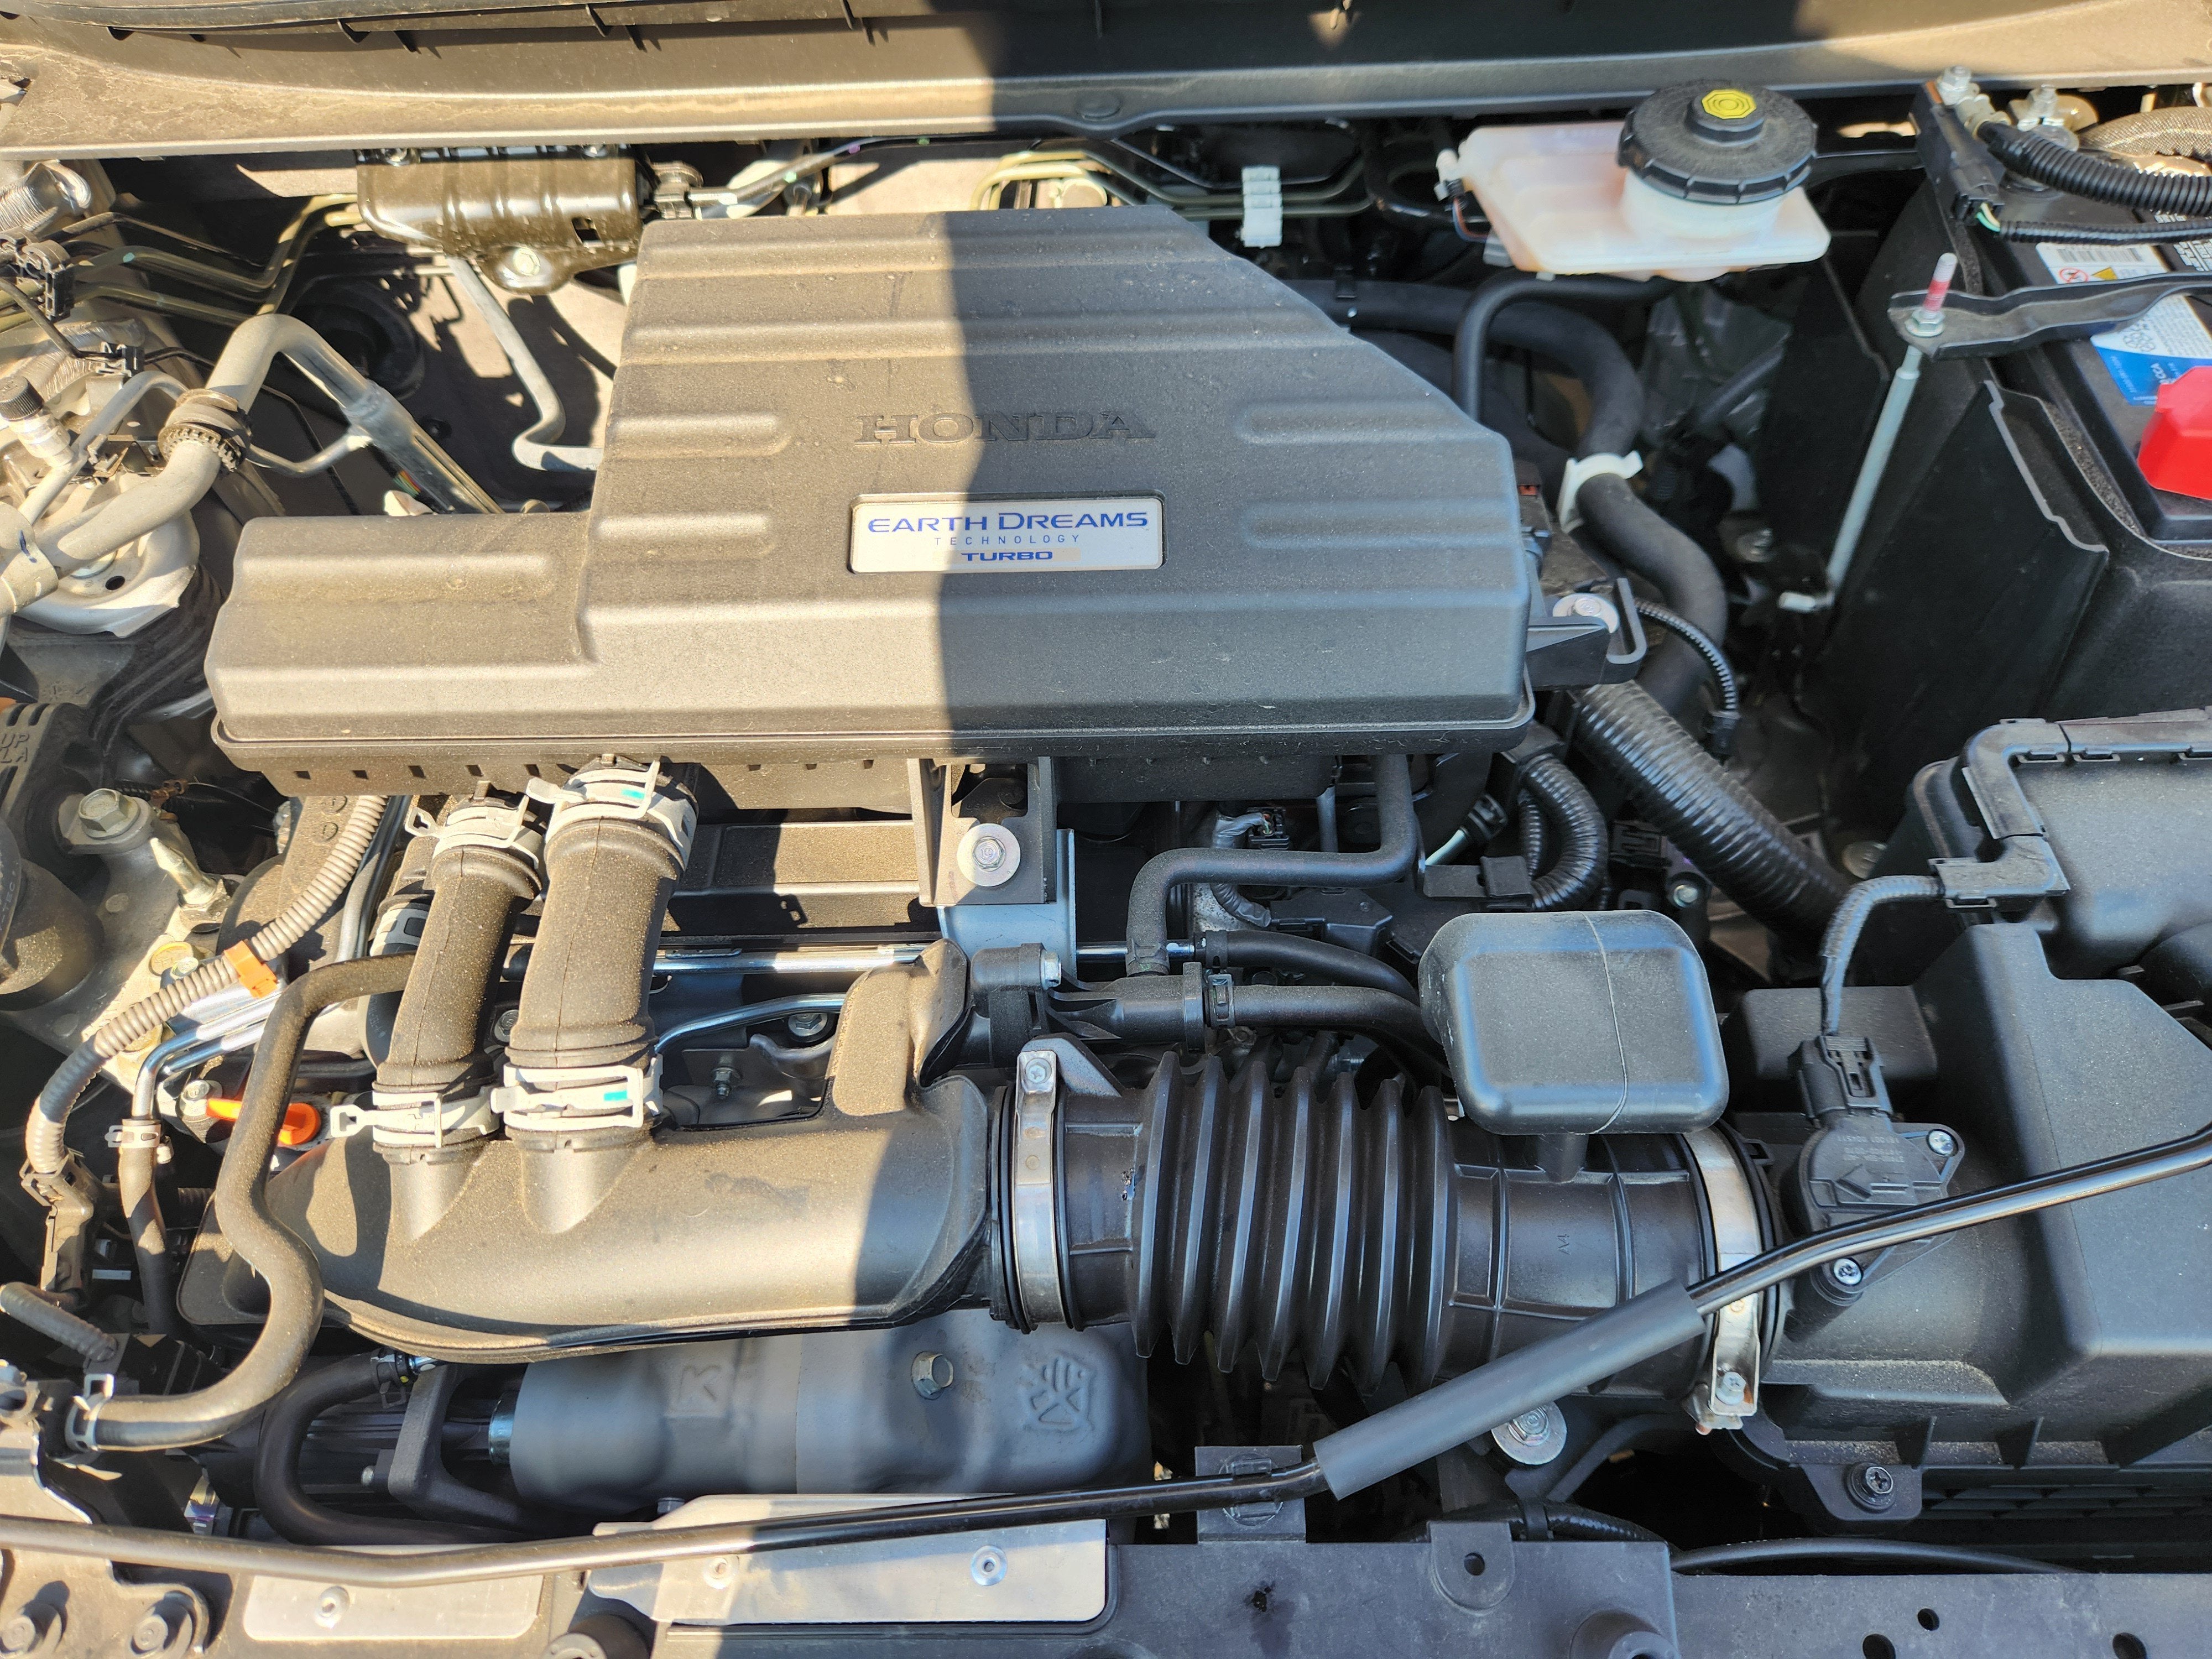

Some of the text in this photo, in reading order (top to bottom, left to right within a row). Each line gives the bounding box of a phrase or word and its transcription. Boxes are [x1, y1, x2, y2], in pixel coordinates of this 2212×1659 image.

[854, 412, 1155, 444] HONDA
[868, 512, 1148, 533] EARTH DREAMS
[934, 534, 1079, 546] TECHNOLOGY
[960, 551, 1053, 562] TURBO
